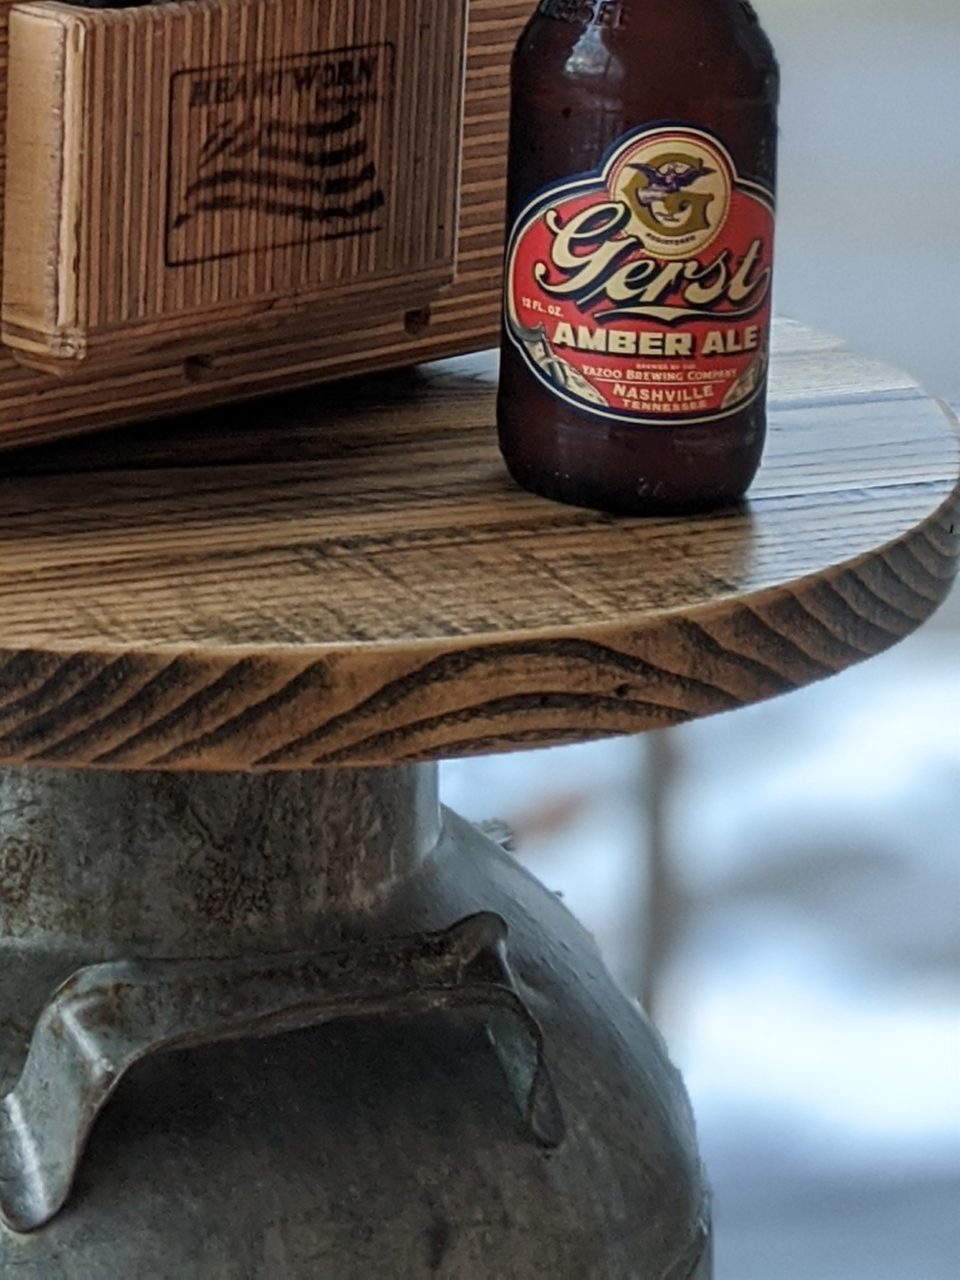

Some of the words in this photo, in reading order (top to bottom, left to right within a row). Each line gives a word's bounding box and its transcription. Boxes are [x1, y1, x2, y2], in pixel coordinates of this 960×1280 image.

[294, 58, 377, 90] WORN
[534, 201, 772, 314] Gerst
[521, 296, 532, 309] 12
[553, 323, 692, 355] AMBER
[702, 326, 759, 354] ALE
[581, 363, 623, 379] YAZOO
[626, 368, 684, 382] BREWING
[687, 367, 738, 381] COMPANY
[612, 382, 715, 403] NASHVILLE
[622, 399, 708, 413] TENNESSEE
